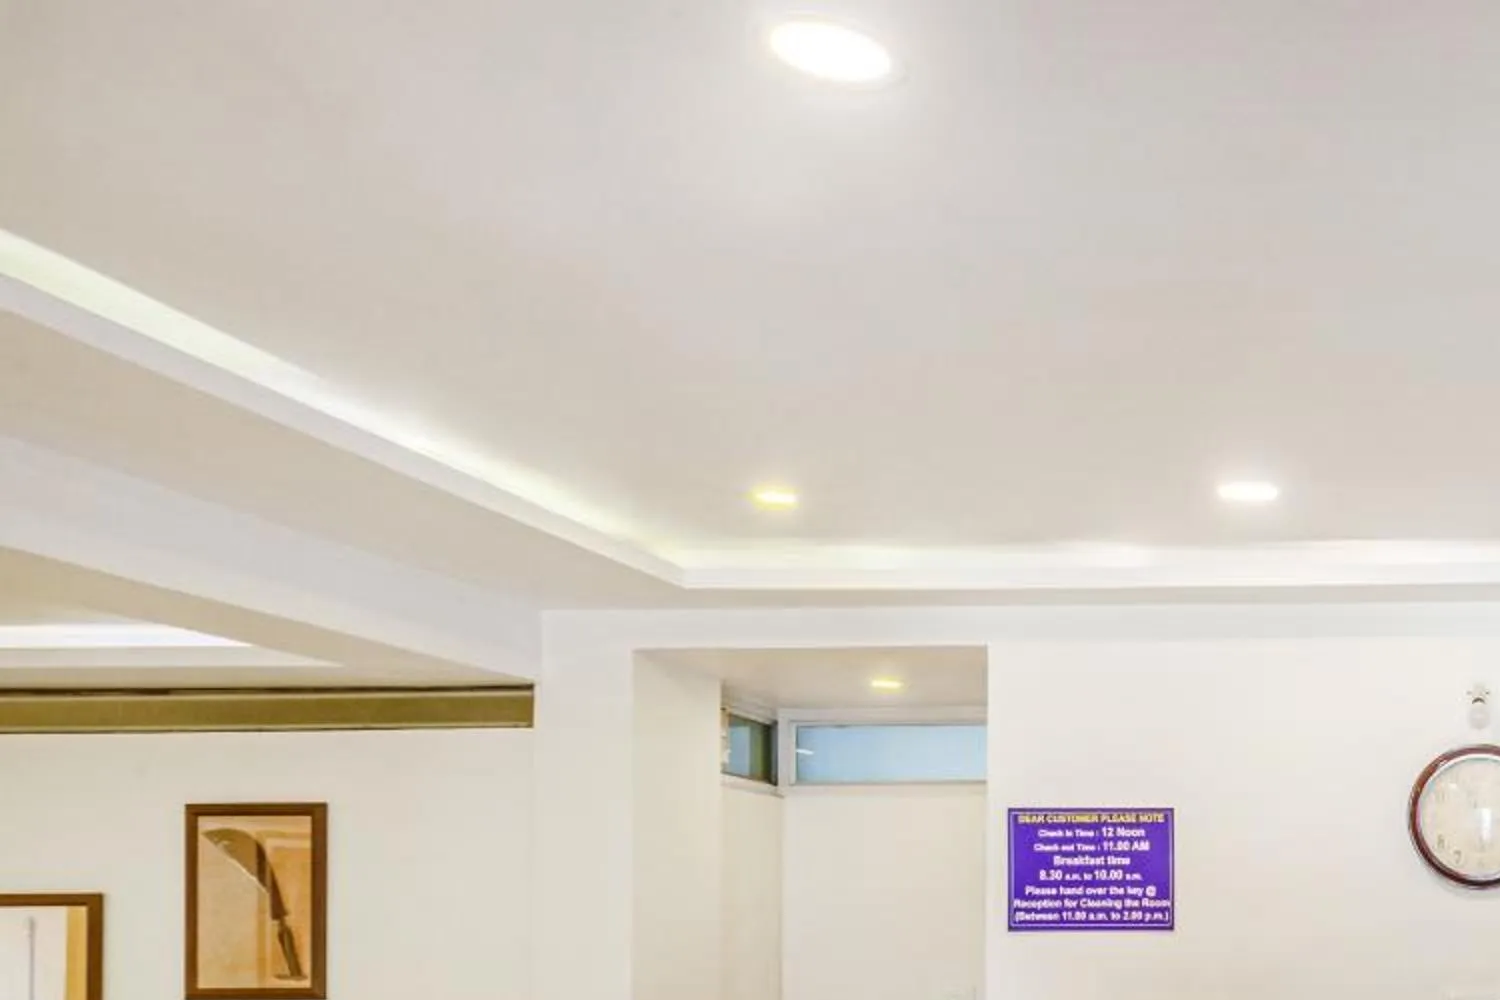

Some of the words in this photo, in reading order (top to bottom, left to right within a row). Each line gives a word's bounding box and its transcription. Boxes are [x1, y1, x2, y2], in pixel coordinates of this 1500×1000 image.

[1018, 814, 1044, 823] DEAR
[1046, 814, 1098, 823] CUSTOMER
[1100, 814, 1137, 823] PLEASE
[1139, 814, 1165, 823] NOTE
[1038, 829, 1063, 837] Check
[1075, 829, 1094, 837] Time
[1102, 827, 1114, 837] 12
[1116, 827, 1146, 837] Noon
[1033, 843, 1060, 851] Check
[1077, 843, 1096, 851] Time
[1103, 840, 1130, 851] 11.00
[1132, 840, 1150, 851] AM
[1053, 855, 1105, 865] Breakfast
[1107, 855, 1131, 865] time
[1039, 869, 1063, 880] 8.30
[1094, 869, 1123, 880] 10.00
[1025, 886, 1057, 895] Please
[1059, 886, 1083, 895] hand
[1085, 887, 1107, 895] over
[1109, 886, 1125, 895] the
[1127, 886, 1144, 897] key
[1013, 899, 1062, 910] Reception
[1063, 899, 1077, 908] for
[1079, 899, 1123, 910] Cleaning
[1124, 899, 1140, 908] the
[1141, 899, 1171, 908] Room
[1062, 912, 1087, 921] 11.00
